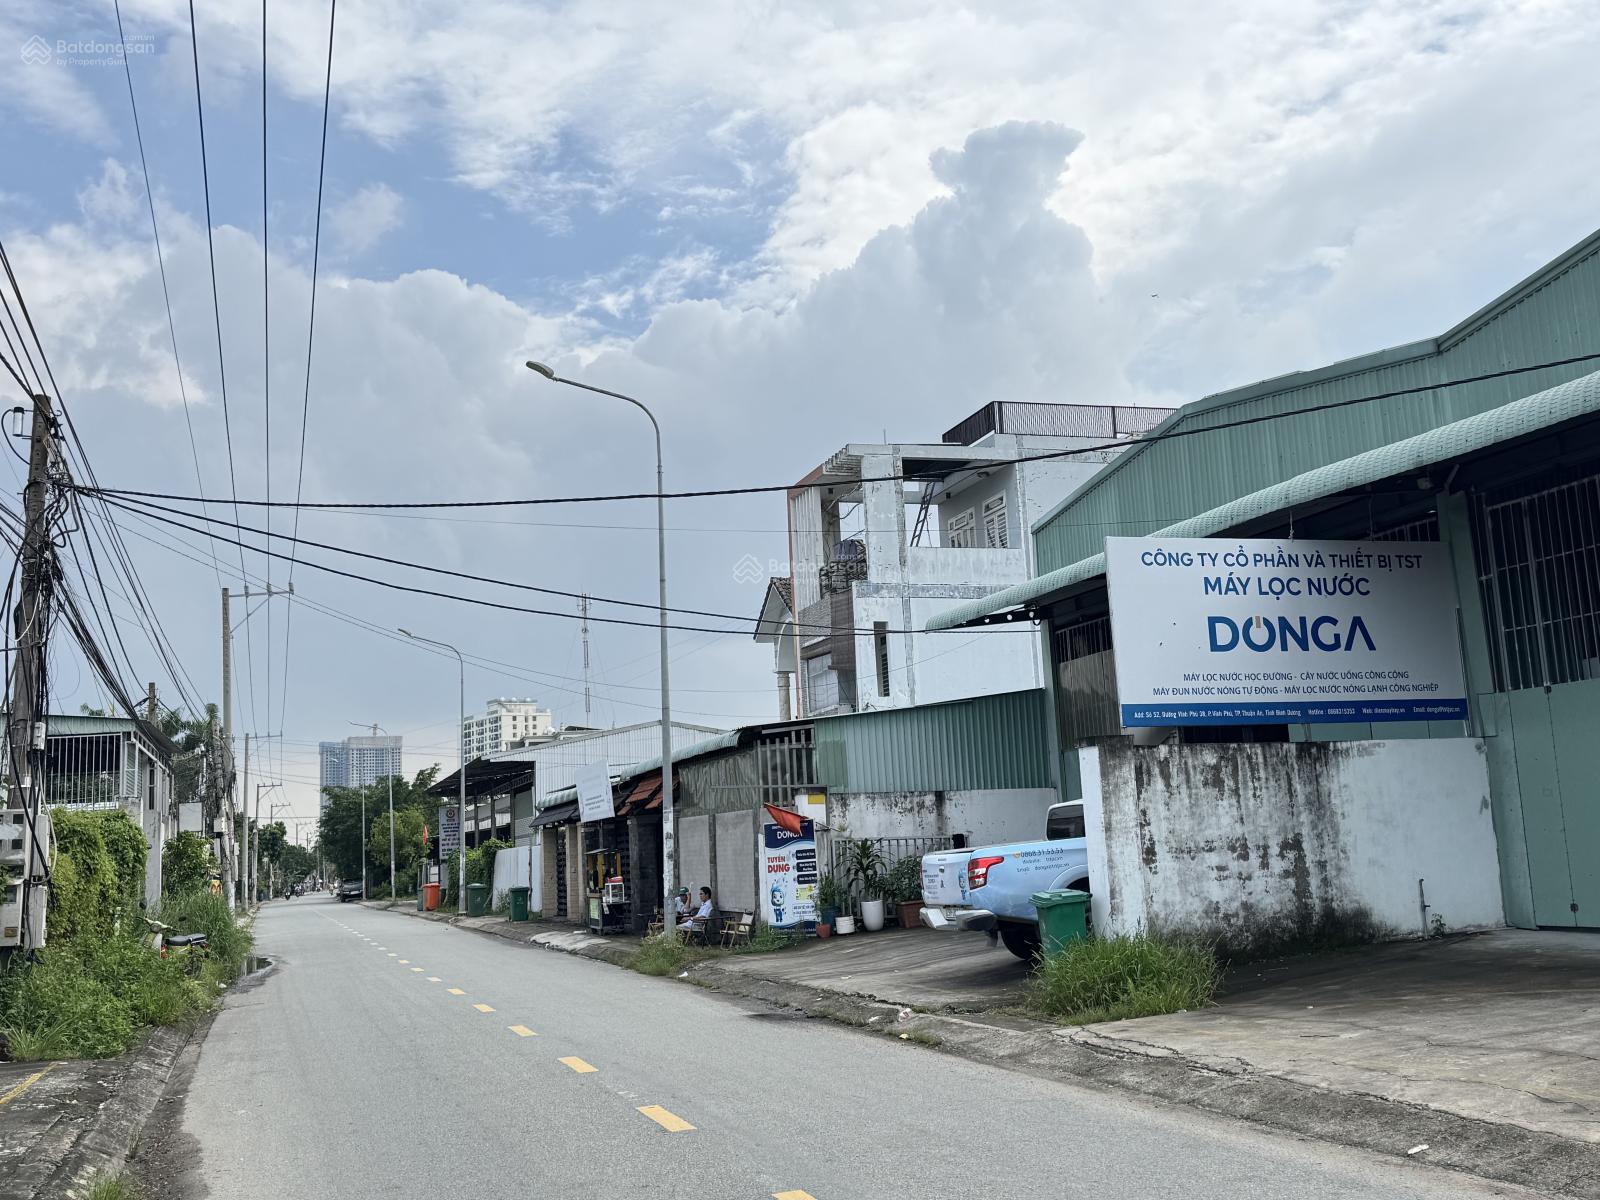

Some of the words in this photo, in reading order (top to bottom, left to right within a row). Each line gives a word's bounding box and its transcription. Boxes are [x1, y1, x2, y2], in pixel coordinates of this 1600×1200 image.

[1141, 548, 1194, 567] CÔNG
[1197, 552, 1219, 567] TY
[1223, 545, 1249, 567] CỔ
[1253, 545, 1300, 568] PHẦN
[1303, 550, 1325, 568] VÀ
[1329, 547, 1373, 569] THIẾT
[1377, 554, 1393, 572] BỊ
[1395, 554, 1423, 569] TST
[1203, 571, 1251, 596] MÁY
[1257, 576, 1302, 601] LỌC
[1307, 572, 1371, 596] NƯỚC
[1207, 615, 1377, 652] DONGA
[1152, 686, 1170, 696] MÁY
[1171, 686, 1190, 696] ĐUN
[1191, 685, 1215, 696] NƯỚC
[1217, 685, 1240, 696] NÓNG
[1242, 685, 1253, 696] TỰ
[1254, 685, 1278, 696] ĐỘNG
[1284, 685, 1301, 695] MÁY
[1302, 685, 1317, 695] LỌC
[1319, 684, 1341, 694] NƯỚC
[1343, 683, 1366, 693] NÓNG
[1367, 683, 1388, 695] LẠNH
[1389, 682, 1411, 693] CÔNG
[1412, 681, 1439, 693] NGHIỆP
[1183, 672, 1200, 681] MÁY
[1202, 673, 1217, 683] LỌC
[1219, 672, 1242, 681] NƯỚC
[1244, 672, 1261, 682] HỌC
[1263, 671, 1293, 681] ĐƯỜNG
[1300, 671, 1315, 680] CÂY
[1316, 671, 1339, 680] NƯỚC
[1340, 669, 1364, 680] UỐNG
[1365, 669, 1386, 680] CÔNG
[1387, 669, 1409, 680] CỘNG
